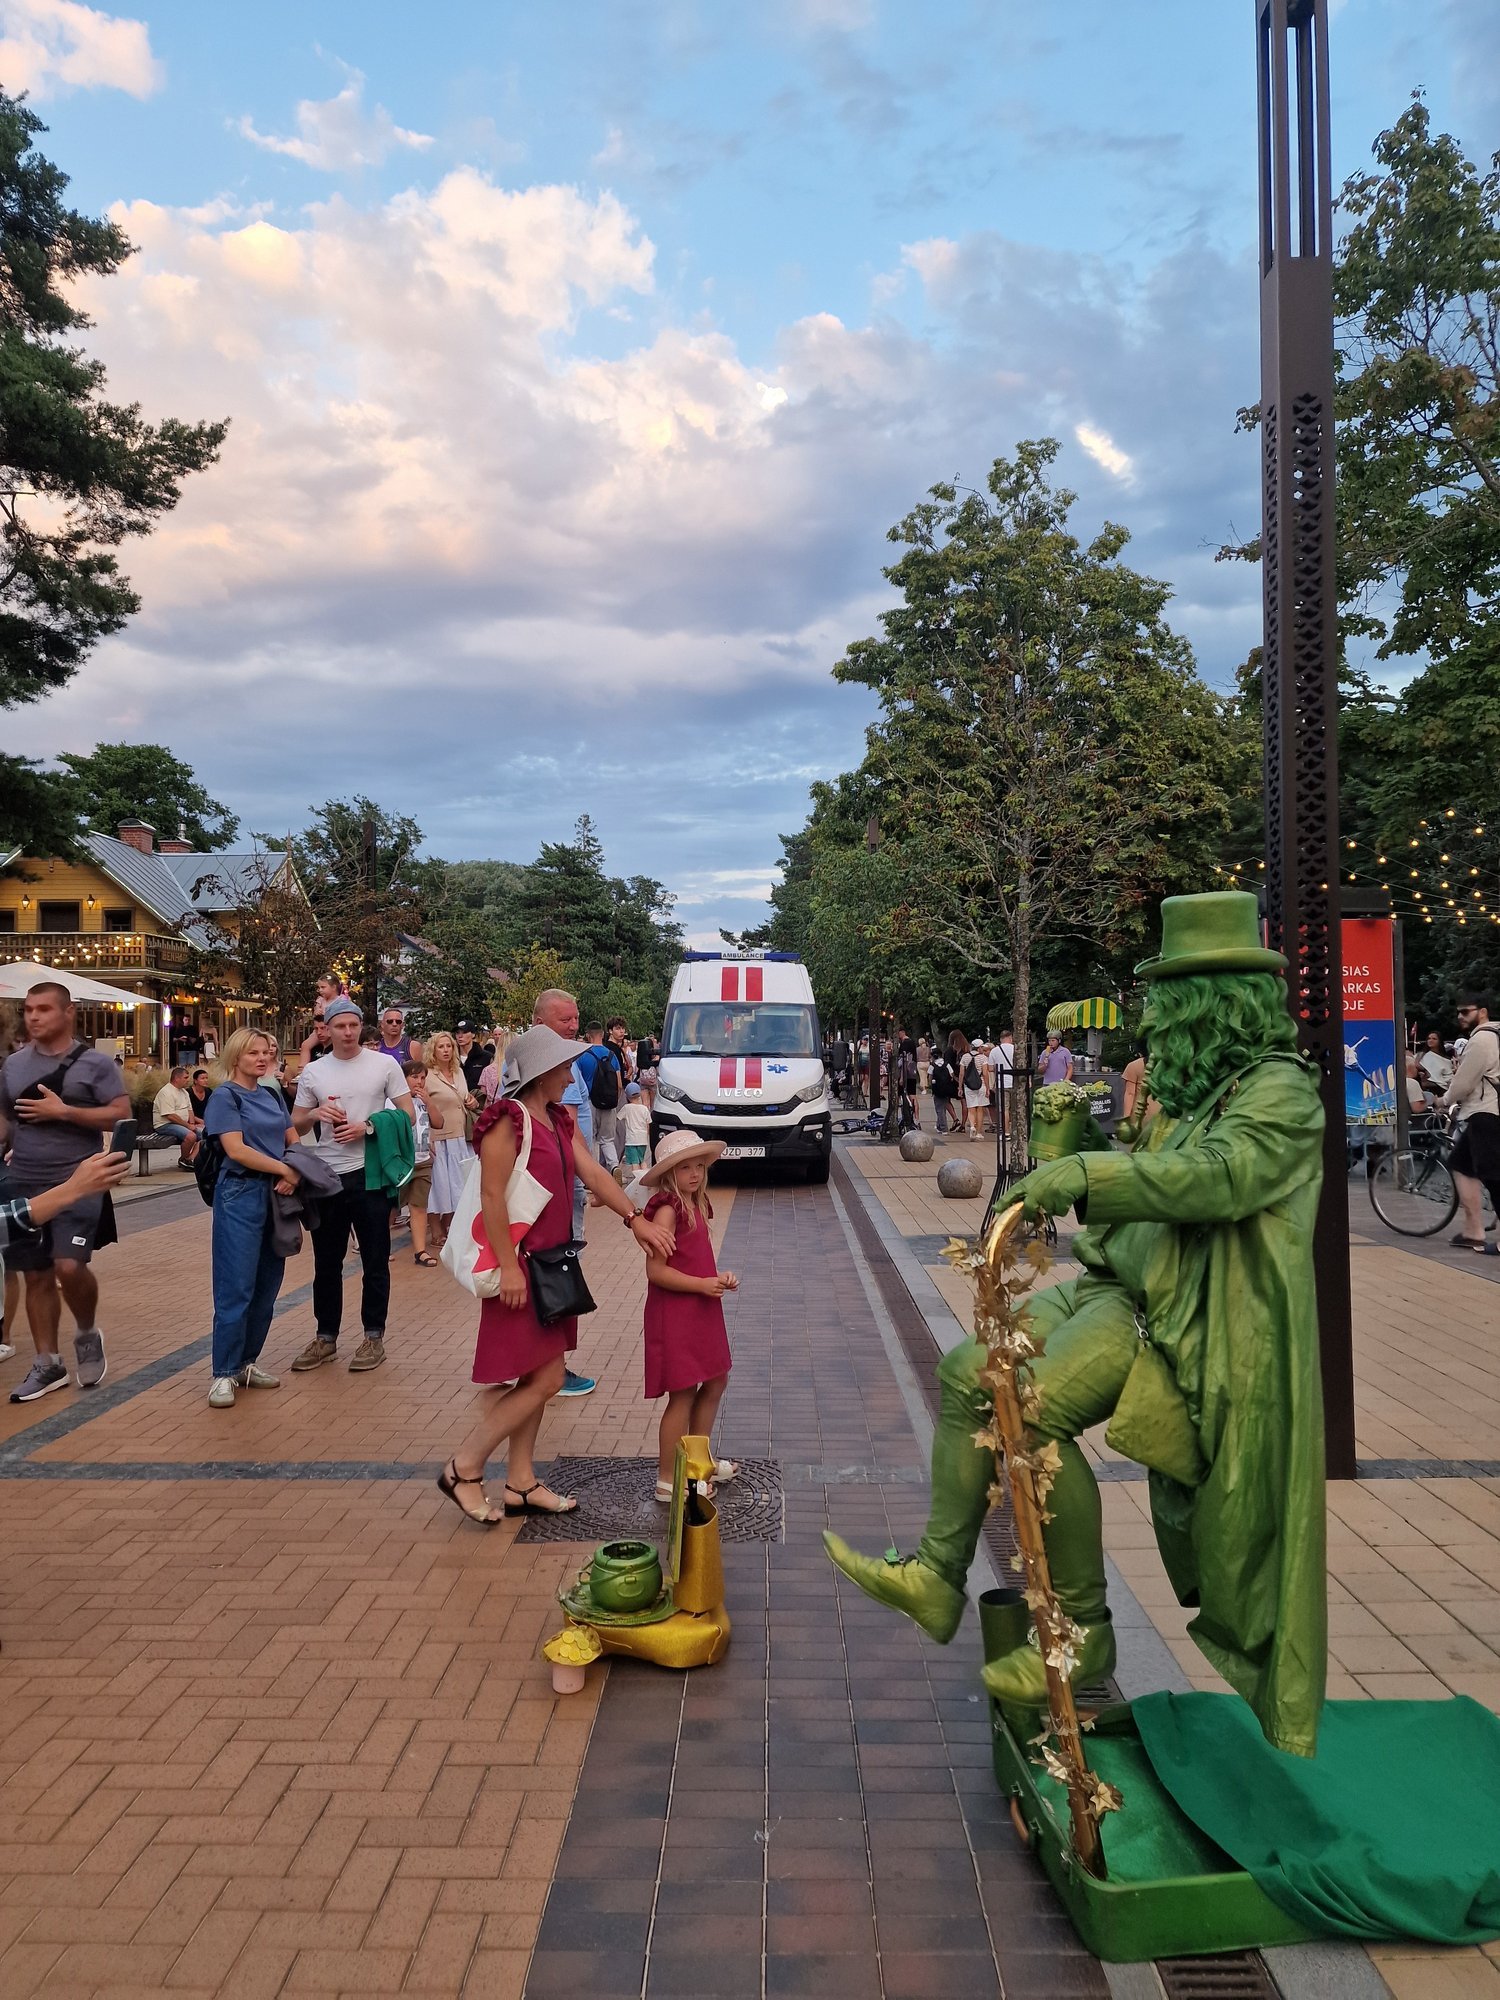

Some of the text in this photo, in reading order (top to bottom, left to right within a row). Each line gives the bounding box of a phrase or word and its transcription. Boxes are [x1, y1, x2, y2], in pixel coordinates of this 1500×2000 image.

[1342, 965, 1370, 976] SIAS
[717, 1088, 763, 1098] IVECO
[722, 1147, 764, 1156] JZD 377
